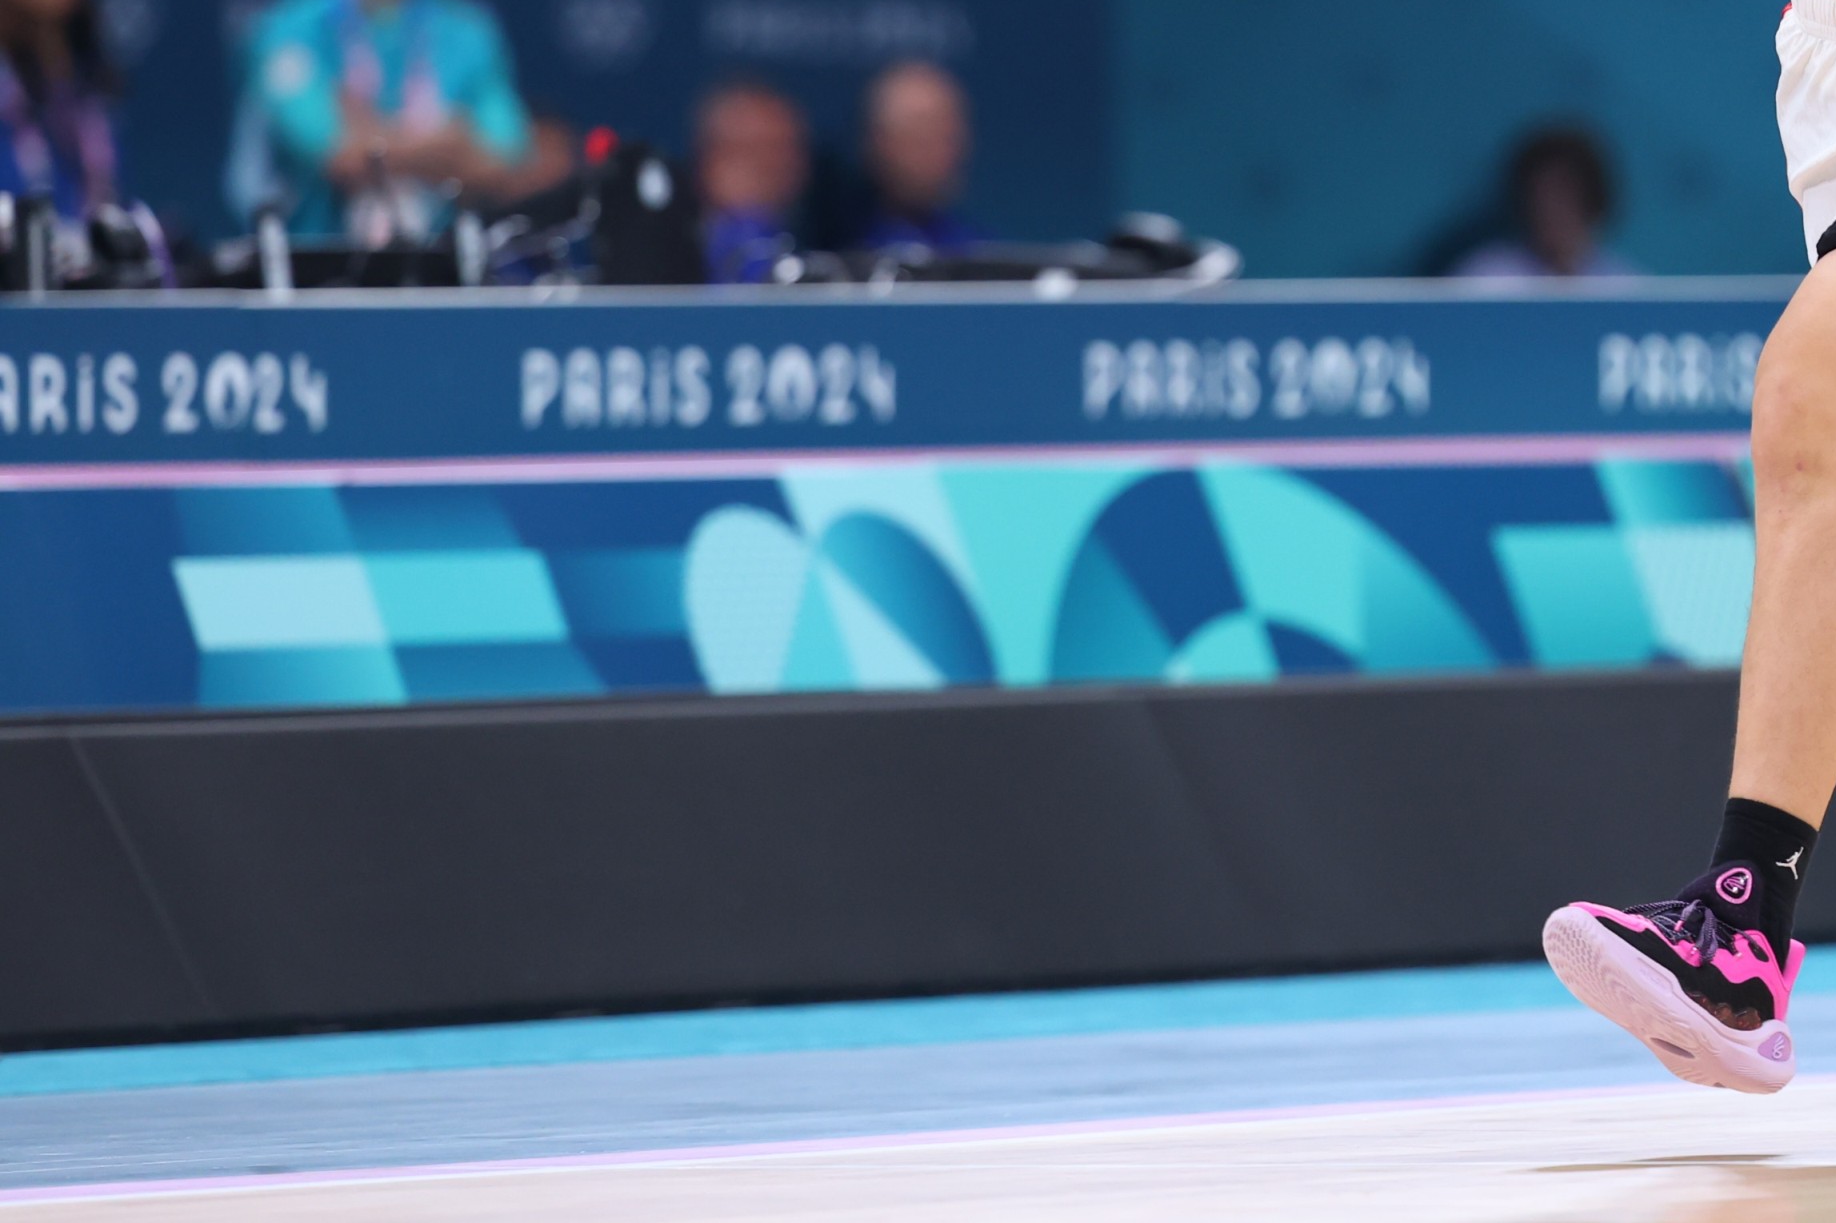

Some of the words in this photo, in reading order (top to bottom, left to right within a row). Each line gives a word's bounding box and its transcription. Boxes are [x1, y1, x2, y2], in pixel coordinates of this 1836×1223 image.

[161, 350, 328, 434] 2024
[726, 343, 897, 426] 2024
[1269, 337, 1430, 419] 2024
